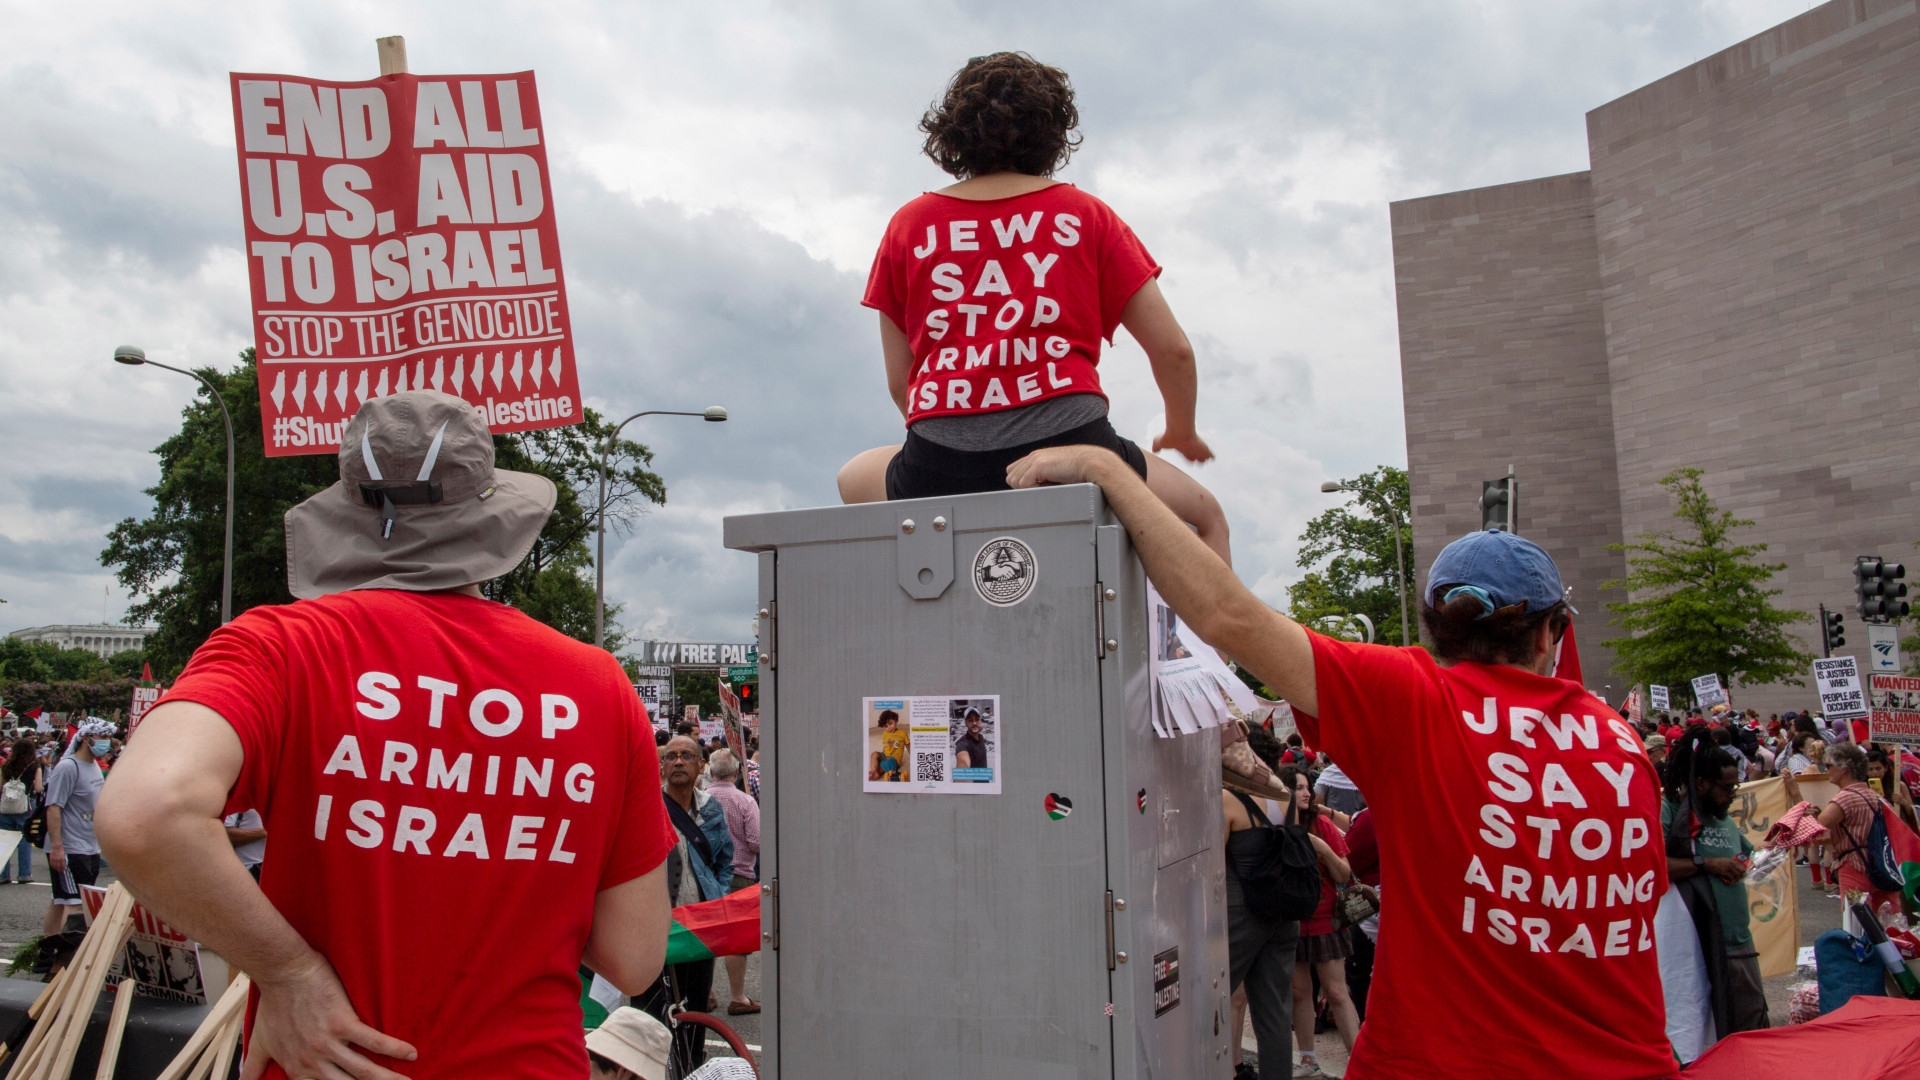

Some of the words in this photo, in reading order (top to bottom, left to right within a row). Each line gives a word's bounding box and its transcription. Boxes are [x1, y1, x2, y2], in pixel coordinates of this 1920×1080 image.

[239, 79, 391, 159] END
[413, 80, 540, 149] ALL
[246, 157, 396, 239] U.S.
[417, 153, 544, 228] AID
[914, 211, 1081, 259] JEWS
[252, 241, 335, 304] TO
[350, 228, 556, 304] ISRAEL
[931, 252, 1059, 301] SAY
[263, 316, 343, 357] STOP
[350, 312, 408, 355] THE
[413, 297, 562, 346] GENOCIDE
[926, 296, 1060, 340] STOP
[917, 336, 1070, 377] ARMING
[908, 362, 1072, 414] ISRAEL
[273, 414, 353, 447] #Shut
[474, 395, 573, 427] alestine
[638, 666, 671, 677] WANTED
[681, 644, 716, 664] FREE
[721, 644, 758, 664] PAL
[729, 667, 752, 676] Constitution
[1815, 659, 1854, 670] RESISTANCE
[1817, 671, 1824, 679] IS
[1826, 668, 1855, 678] JUSTIFIED
[135, 688, 158, 701] END
[356, 671, 578, 739] STOP
[1822, 692, 1848, 703] PEOPLE
[1849, 691, 1862, 700] ARE
[1826, 701, 1862, 712] OCCUPIED!
[1829, 678, 1849, 688] WHEN
[1872, 676, 1920, 690] WANTED
[1462, 697, 1641, 754] JEWS
[1872, 711, 1920, 724] BENJAMIN
[323, 735, 595, 804] ARMING
[1487, 752, 1634, 808] SAY
[314, 795, 576, 864] ISRAEL
[1479, 804, 1648, 861] STOP
[1464, 854, 1655, 909] ARMING
[1462, 896, 1652, 958] ISRAEL
[1155, 960, 1166, 982] FREE
[1155, 981, 1180, 1011] PALESTINE
